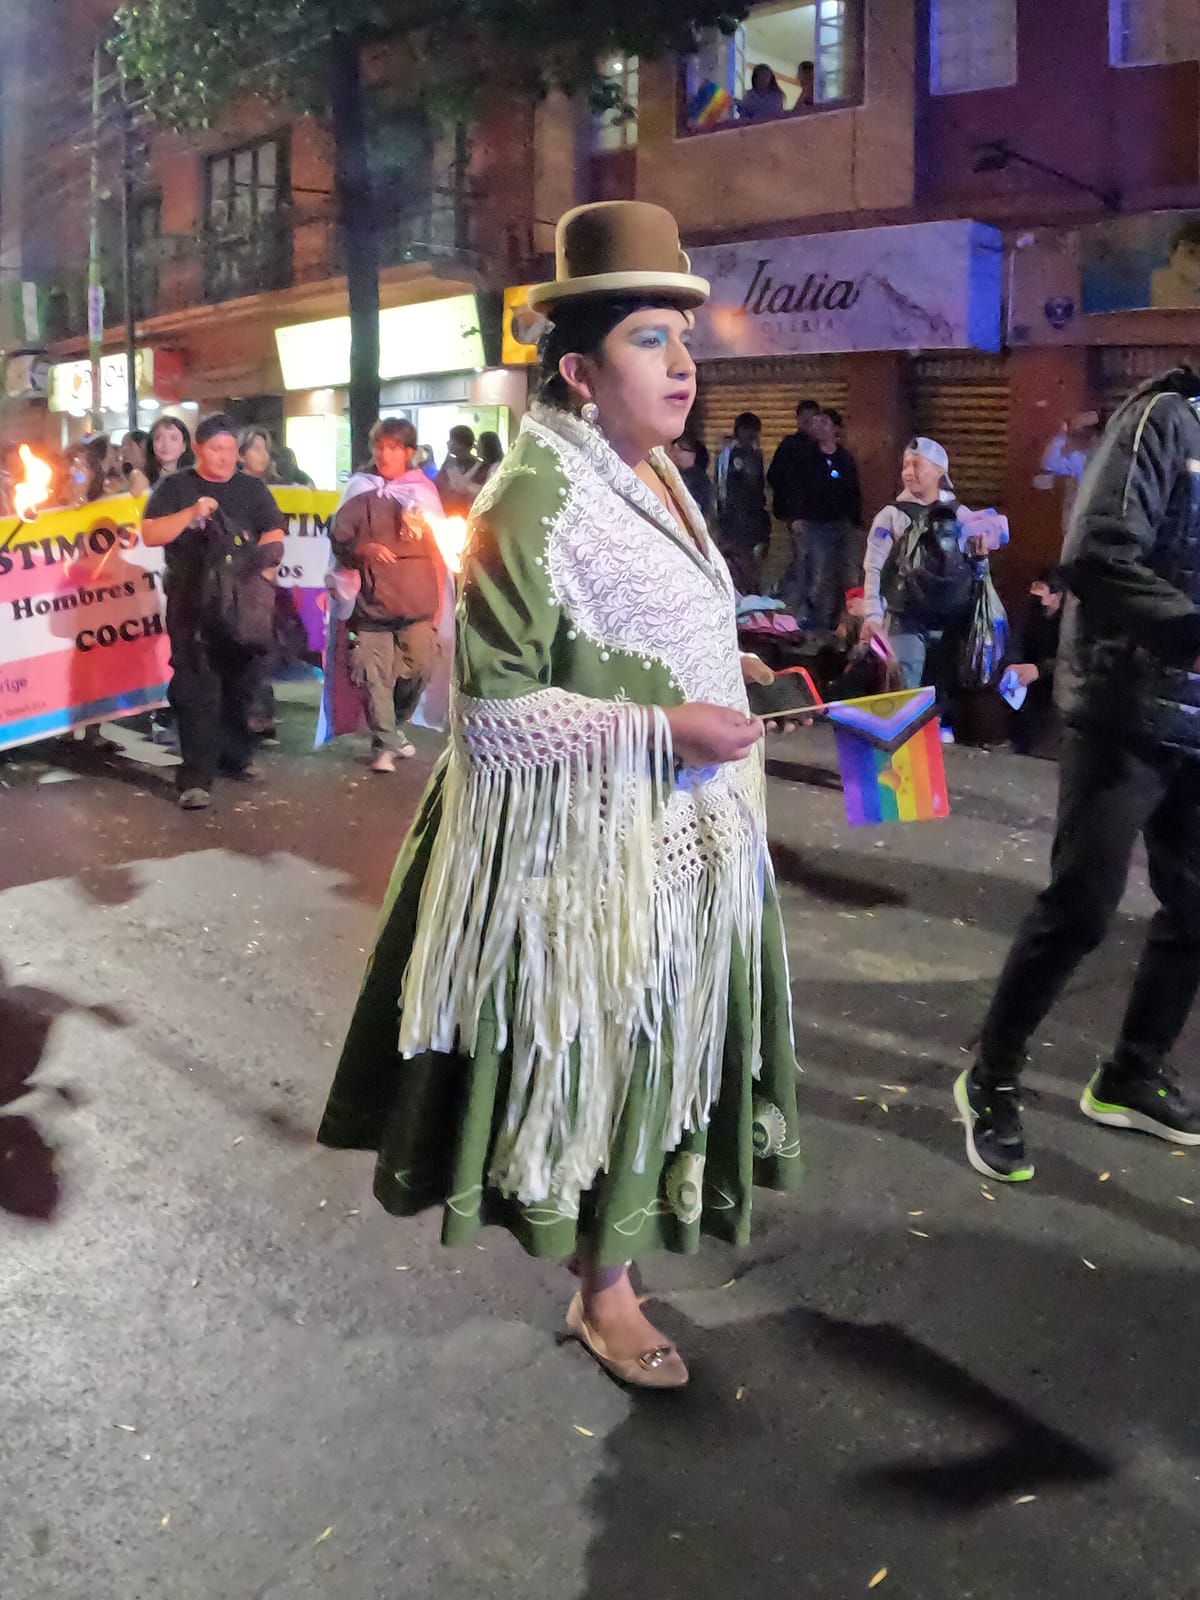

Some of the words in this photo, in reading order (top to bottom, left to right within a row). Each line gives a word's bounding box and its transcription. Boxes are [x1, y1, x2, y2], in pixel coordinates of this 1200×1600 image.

[740, 259, 860, 316] Italia
[12, 581, 136, 620] Hombres
[75, 612, 163, 651] COCH
